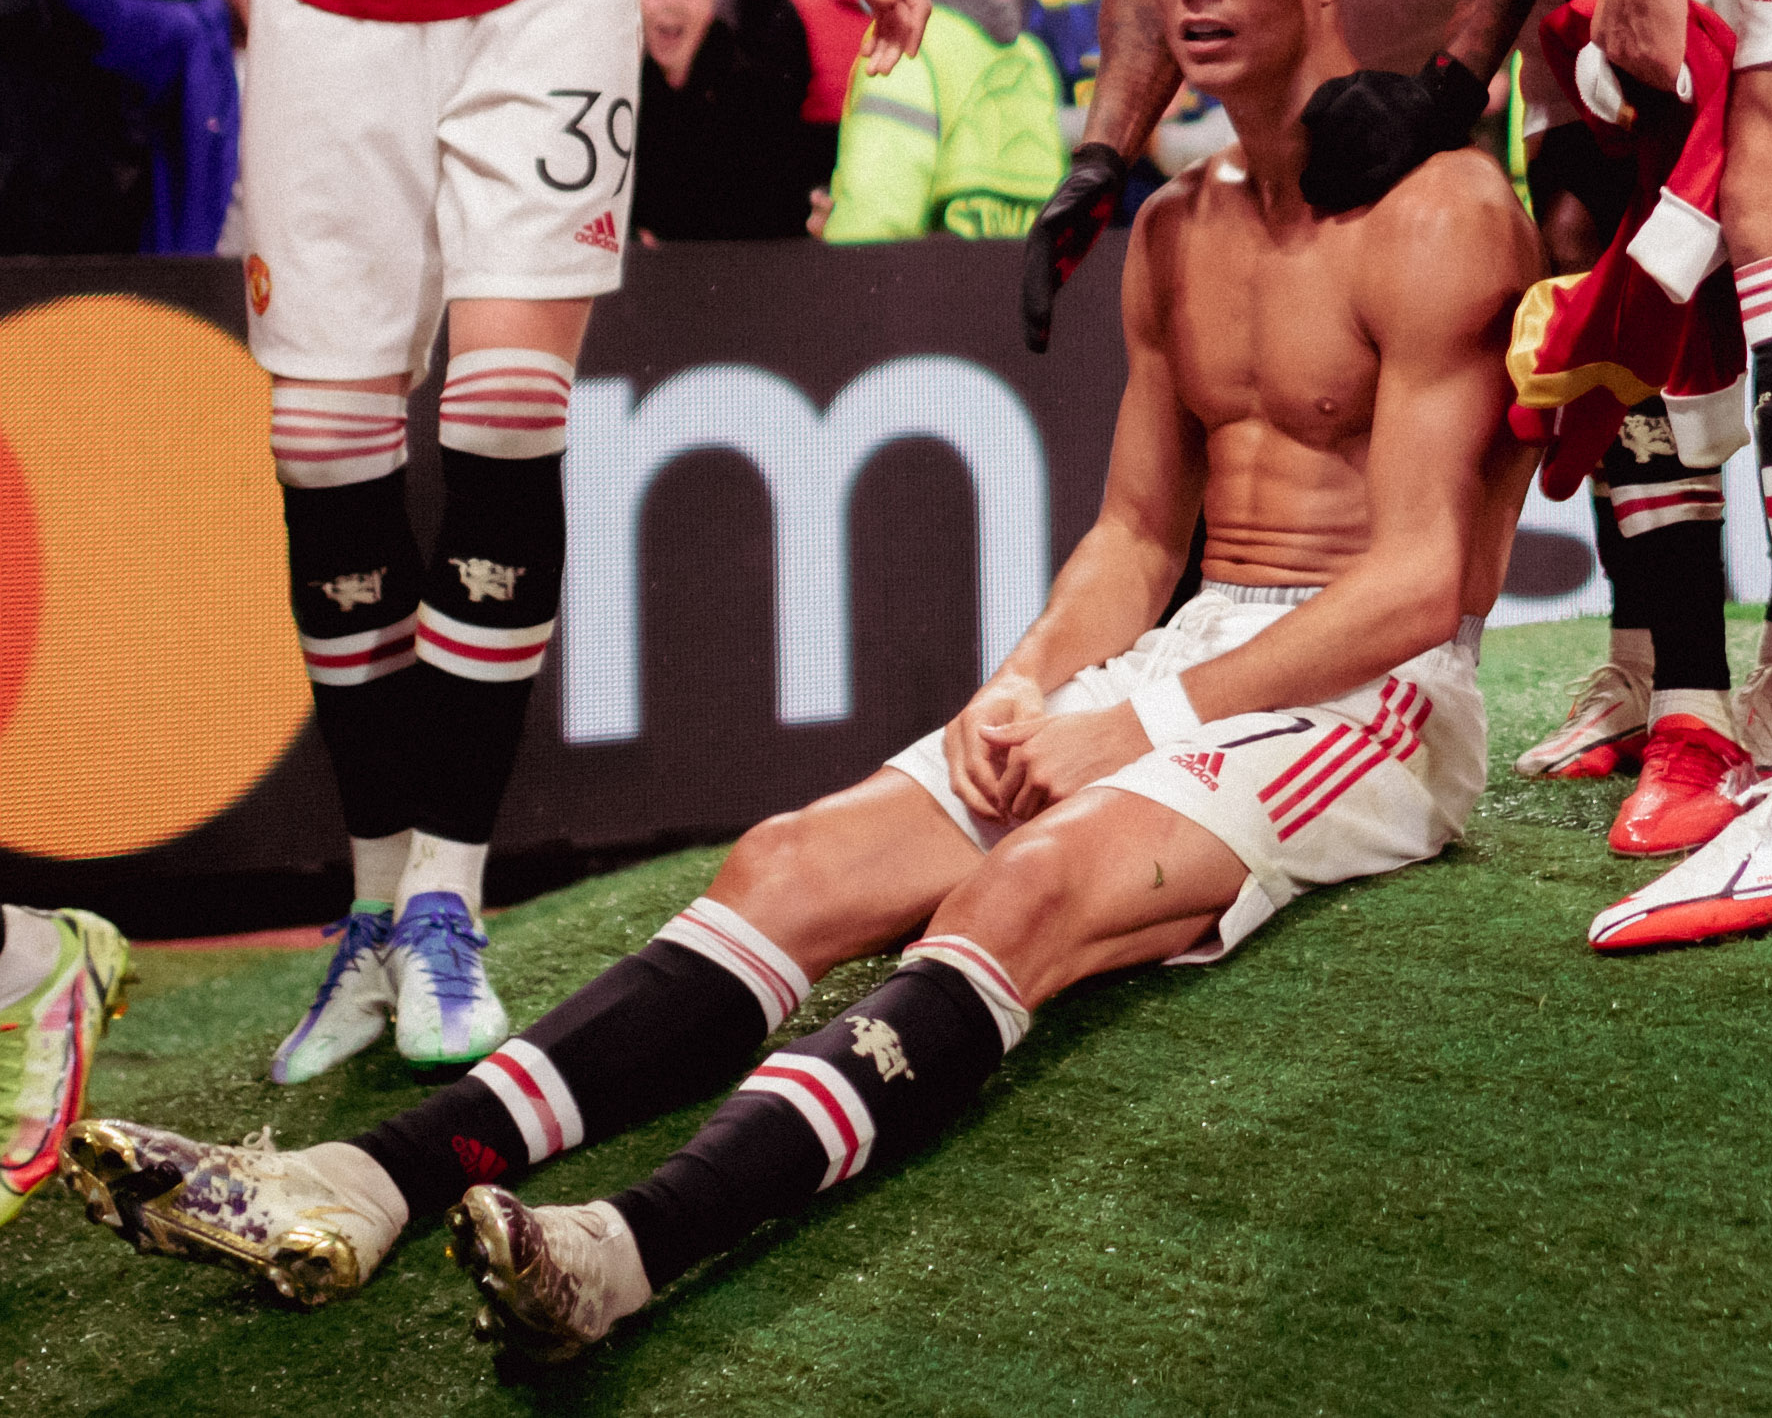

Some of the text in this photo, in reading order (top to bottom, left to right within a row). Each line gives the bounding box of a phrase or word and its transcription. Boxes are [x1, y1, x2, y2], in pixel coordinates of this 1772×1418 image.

[536, 90, 634, 198] 39
[573, 231, 620, 254] adidas
[1169, 754, 1219, 792] adidas
